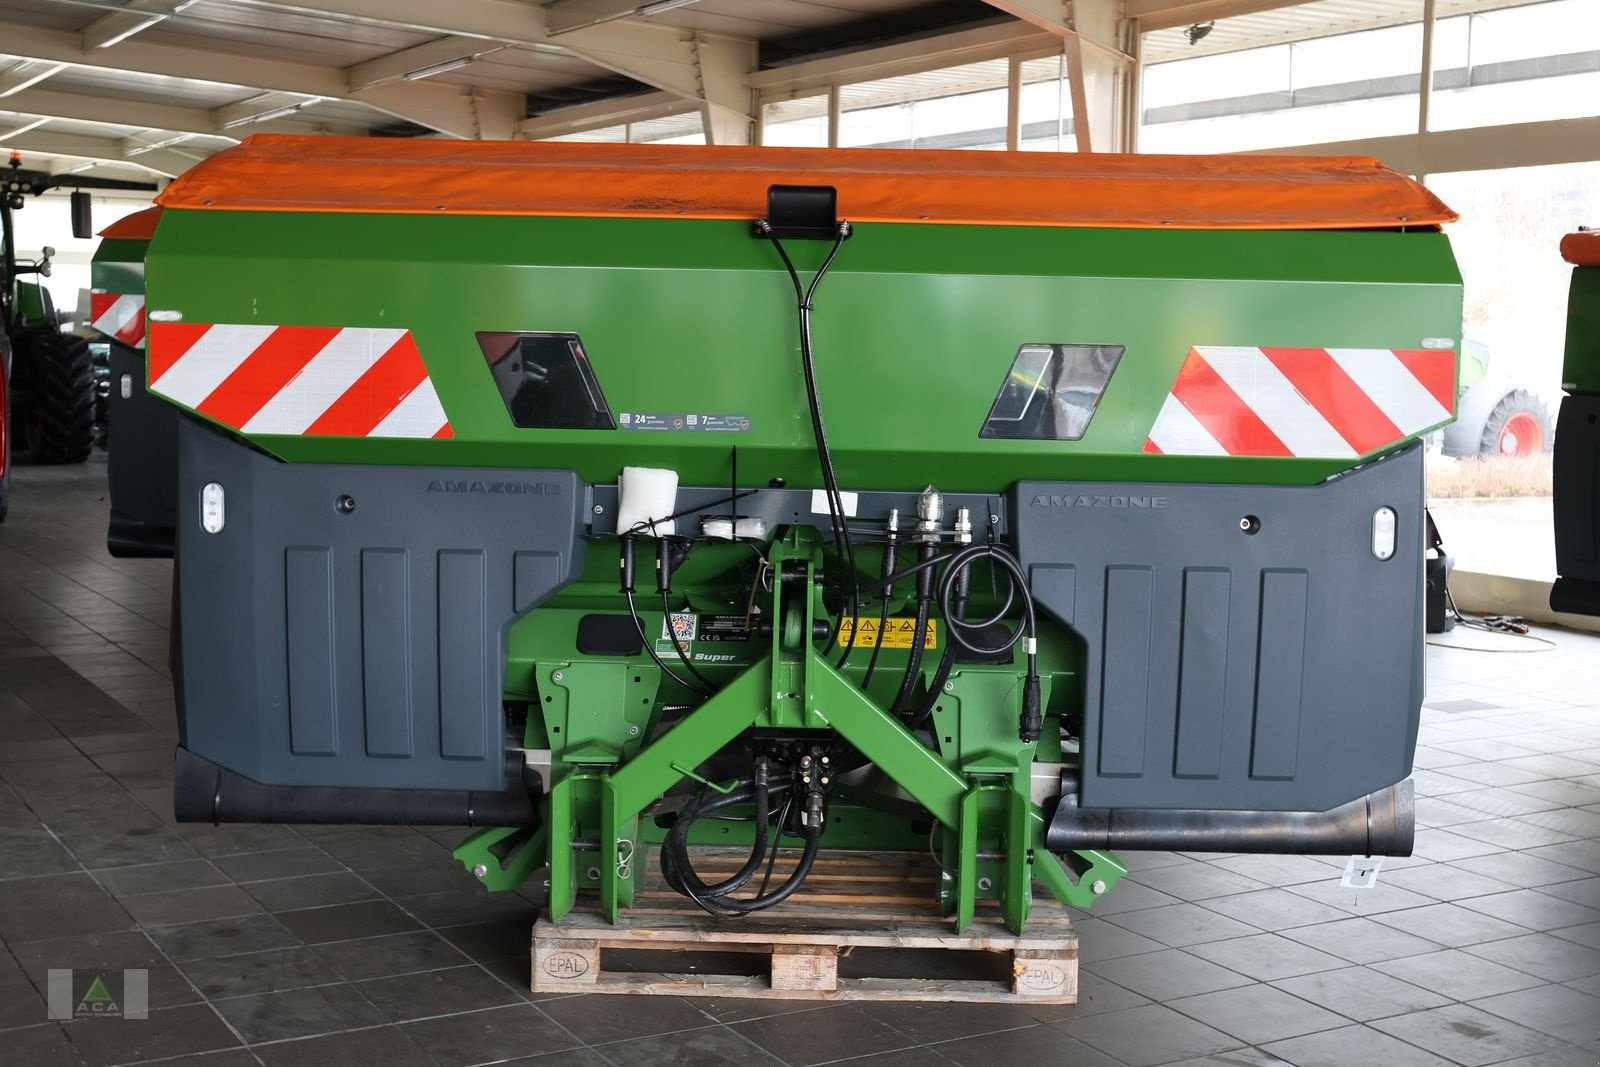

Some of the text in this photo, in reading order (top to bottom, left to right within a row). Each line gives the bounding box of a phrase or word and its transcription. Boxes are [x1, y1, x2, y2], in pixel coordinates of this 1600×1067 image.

[635, 414, 646, 424] 24
[701, 415, 708, 425] 7
[426, 480, 561, 496] AMAZONE
[1030, 495, 1168, 509] AMAZONE
[694, 653, 736, 662] Super
[549, 958, 583, 973] EPAL
[1026, 969, 1059, 985] EPAL
